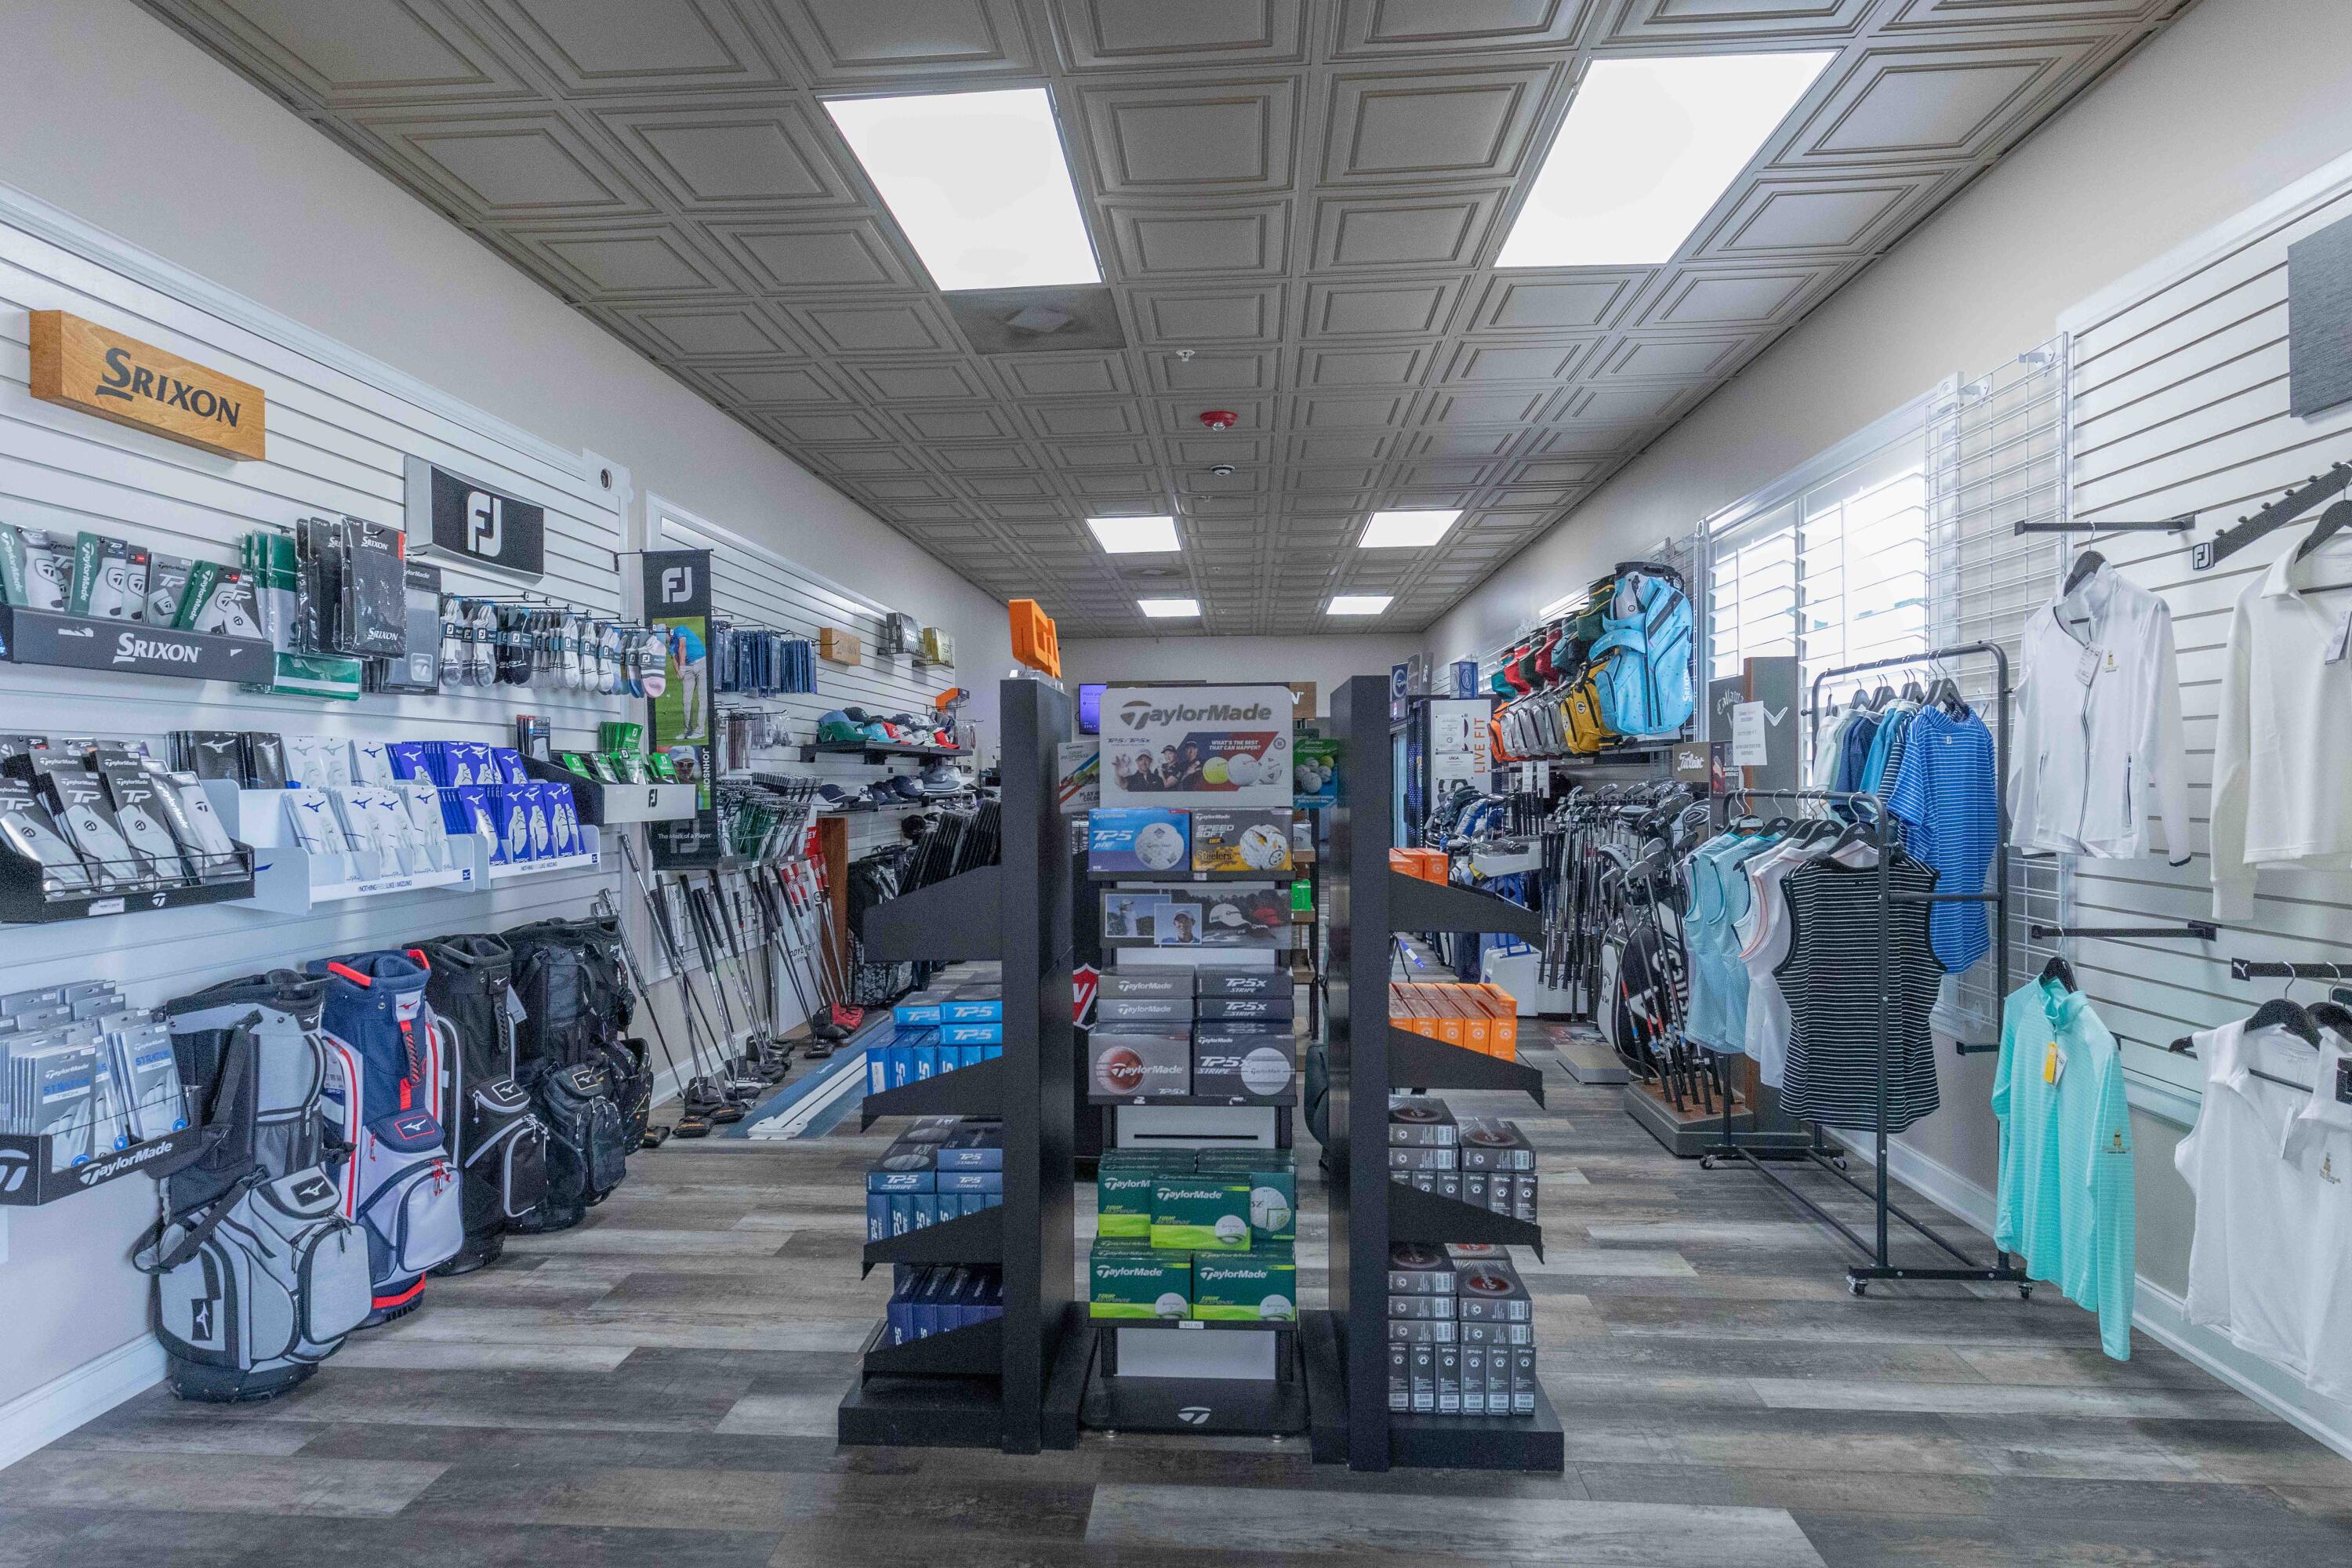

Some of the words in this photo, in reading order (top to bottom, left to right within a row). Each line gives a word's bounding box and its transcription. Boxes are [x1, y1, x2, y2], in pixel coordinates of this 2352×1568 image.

[99, 347, 241, 428] SRIXON
[467, 491, 502, 557] FJ
[361, 536, 389, 550] SRIXON
[2, 532, 24, 593] TaylorMade
[158, 561, 187, 572] TaylorMade
[80, 542, 95, 601] TaylorMade
[159, 573, 187, 588] TP
[662, 567, 692, 604] FJ
[189, 569, 213, 621] TaylorMade
[367, 626, 398, 641] SRIXON
[512, 633, 520, 643] FJ
[116, 632, 201, 663] SRIXON
[642, 654, 651, 662] FJ
[1120, 700, 1272, 730] TaylorMade
[1474, 717, 1486, 739] FIT
[40, 757, 78, 766] TaylorMade
[104, 758, 138, 768] TaylorMade
[1474, 743, 1486, 773] LIVE
[1678, 750, 1704, 772] Titleist
[702, 748, 710, 791] JOHNSON
[61, 778, 97, 786] TaylorMade
[67, 789, 101, 803] TP
[122, 790, 152, 803] TP
[648, 789, 658, 808] FJ
[0, 797, 35, 811] TP
[1093, 830, 1134, 840] TP5
[1196, 850, 1232, 861] Steelers
[1118, 980, 1173, 992] TaylorMade
[1225, 978, 1268, 987] TP5x
[953, 1006, 995, 1018] TP5
[1118, 1004, 1172, 1015] TaylorMade
[1225, 1001, 1268, 1011] TP5x
[953, 1029, 995, 1040] TP5
[1198, 1036, 1233, 1045] TaylorMade
[133, 1039, 165, 1051] TaylorMade
[1200, 1056, 1253, 1067] TP5x
[45, 1063, 89, 1080] TaylorMade
[1111, 1063, 1185, 1078] TaylorMade
[80, 1142, 173, 1185] TaylorMade
[887, 1174, 919, 1184] TP5
[1104, 1178, 1150, 1191] TaylorM
[1157, 1188, 1223, 1201] TaylorMade
[870, 1218, 879, 1241] TP5
[1096, 1265, 1164, 1279] TaylorMade
[1200, 1267, 1268, 1281] TaylorMade
